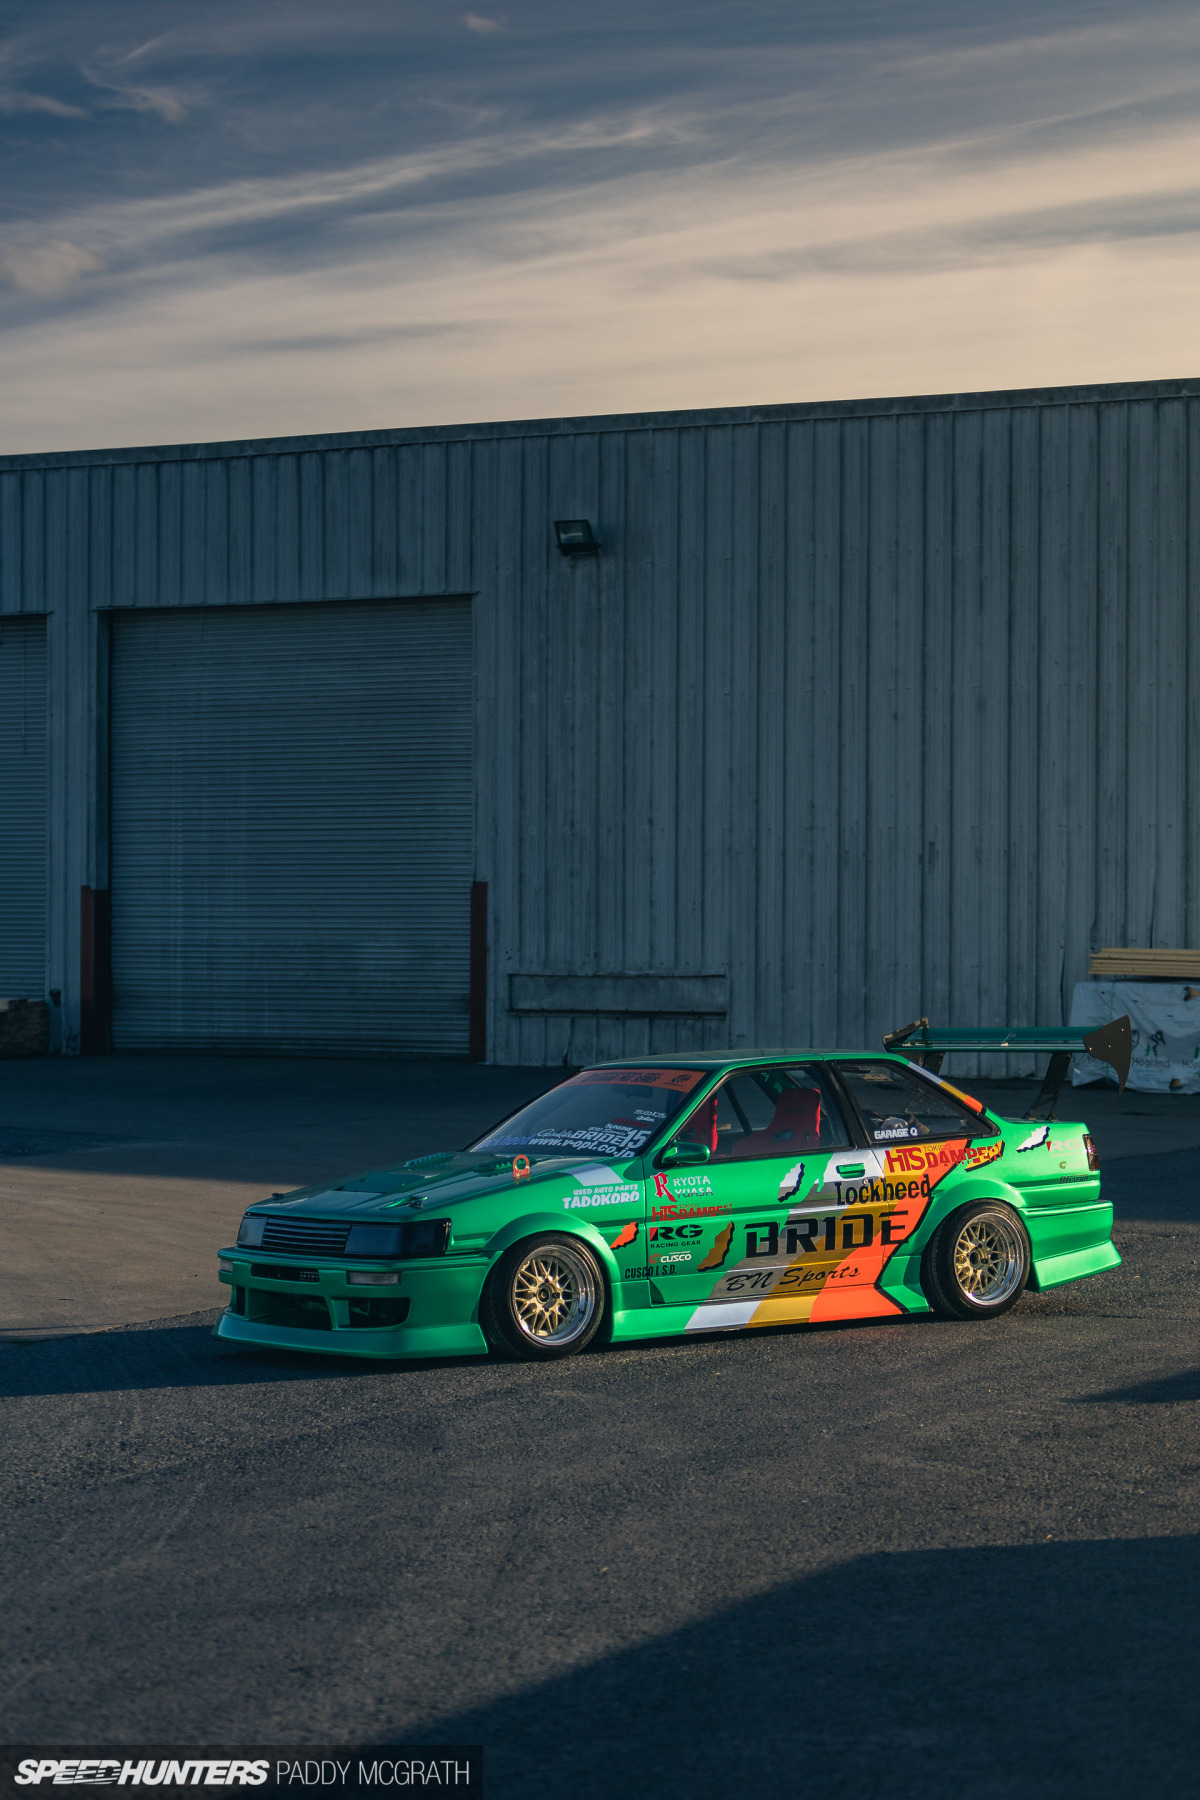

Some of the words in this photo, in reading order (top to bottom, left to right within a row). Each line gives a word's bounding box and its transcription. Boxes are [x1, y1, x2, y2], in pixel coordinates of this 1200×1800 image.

[571, 1130, 627, 1147] BRIDE
[874, 1128, 909, 1140] GARAGE
[673, 1175, 711, 1187] RYOTA
[573, 1187, 593, 1196] USED
[593, 1186, 613, 1194] AUTO
[614, 1184, 638, 1192] PARTS
[674, 1187, 714, 1199] YUASA
[562, 1191, 640, 1209] TADOKORO
[743, 1210, 909, 1258] BRIDE
[660, 1254, 692, 1263] CUSCO
[625, 1266, 654, 1279] CUSCO
[779, 1265, 861, 1287] Sports
